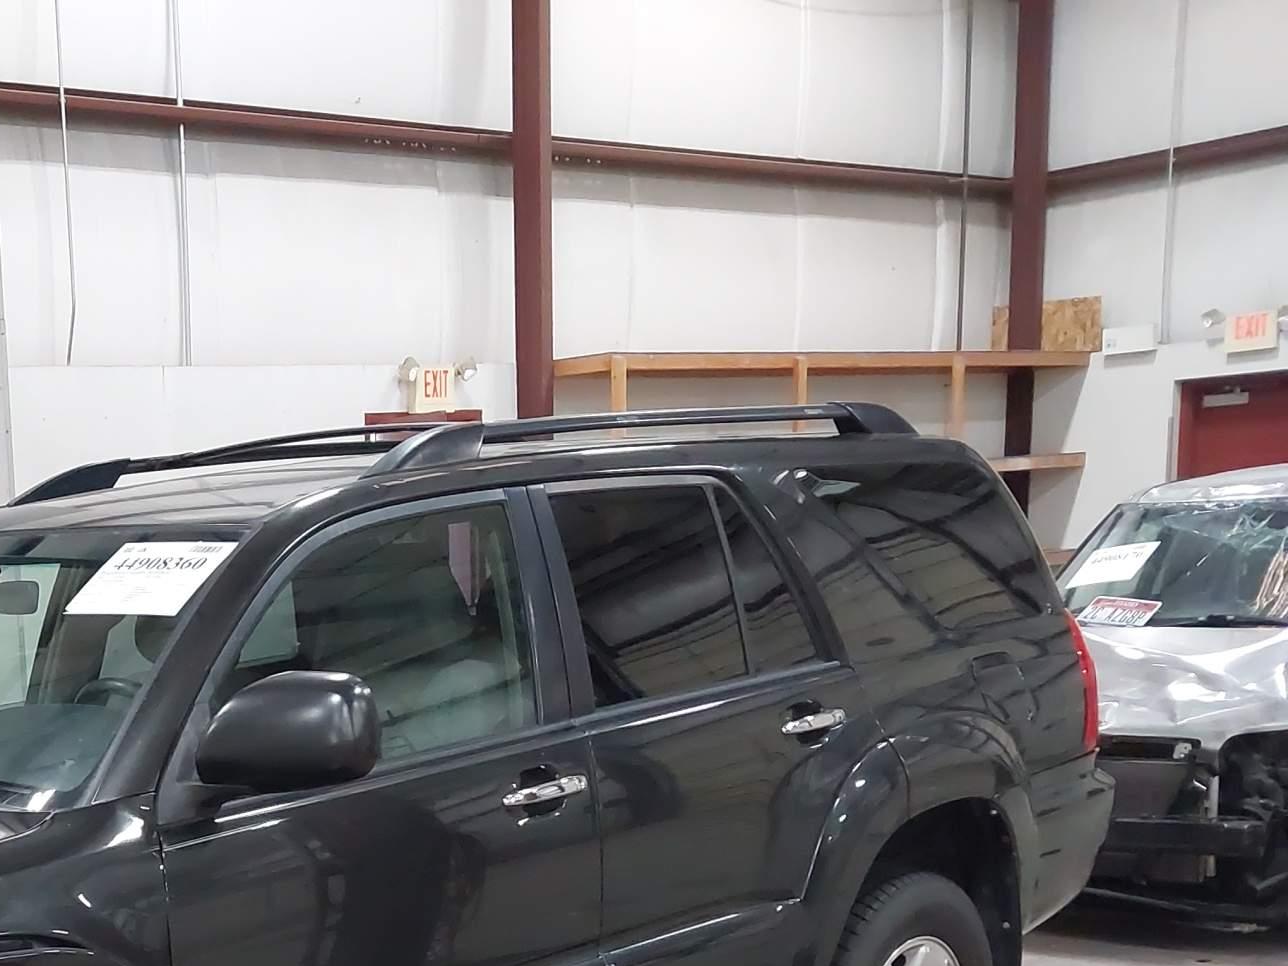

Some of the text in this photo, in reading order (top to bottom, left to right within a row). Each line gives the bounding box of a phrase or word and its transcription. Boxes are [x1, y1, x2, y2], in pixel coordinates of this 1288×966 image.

[1234, 313, 1269, 340] EXIT
[424, 369, 449, 398] EXIT
[113, 556, 208, 571] 44908360
